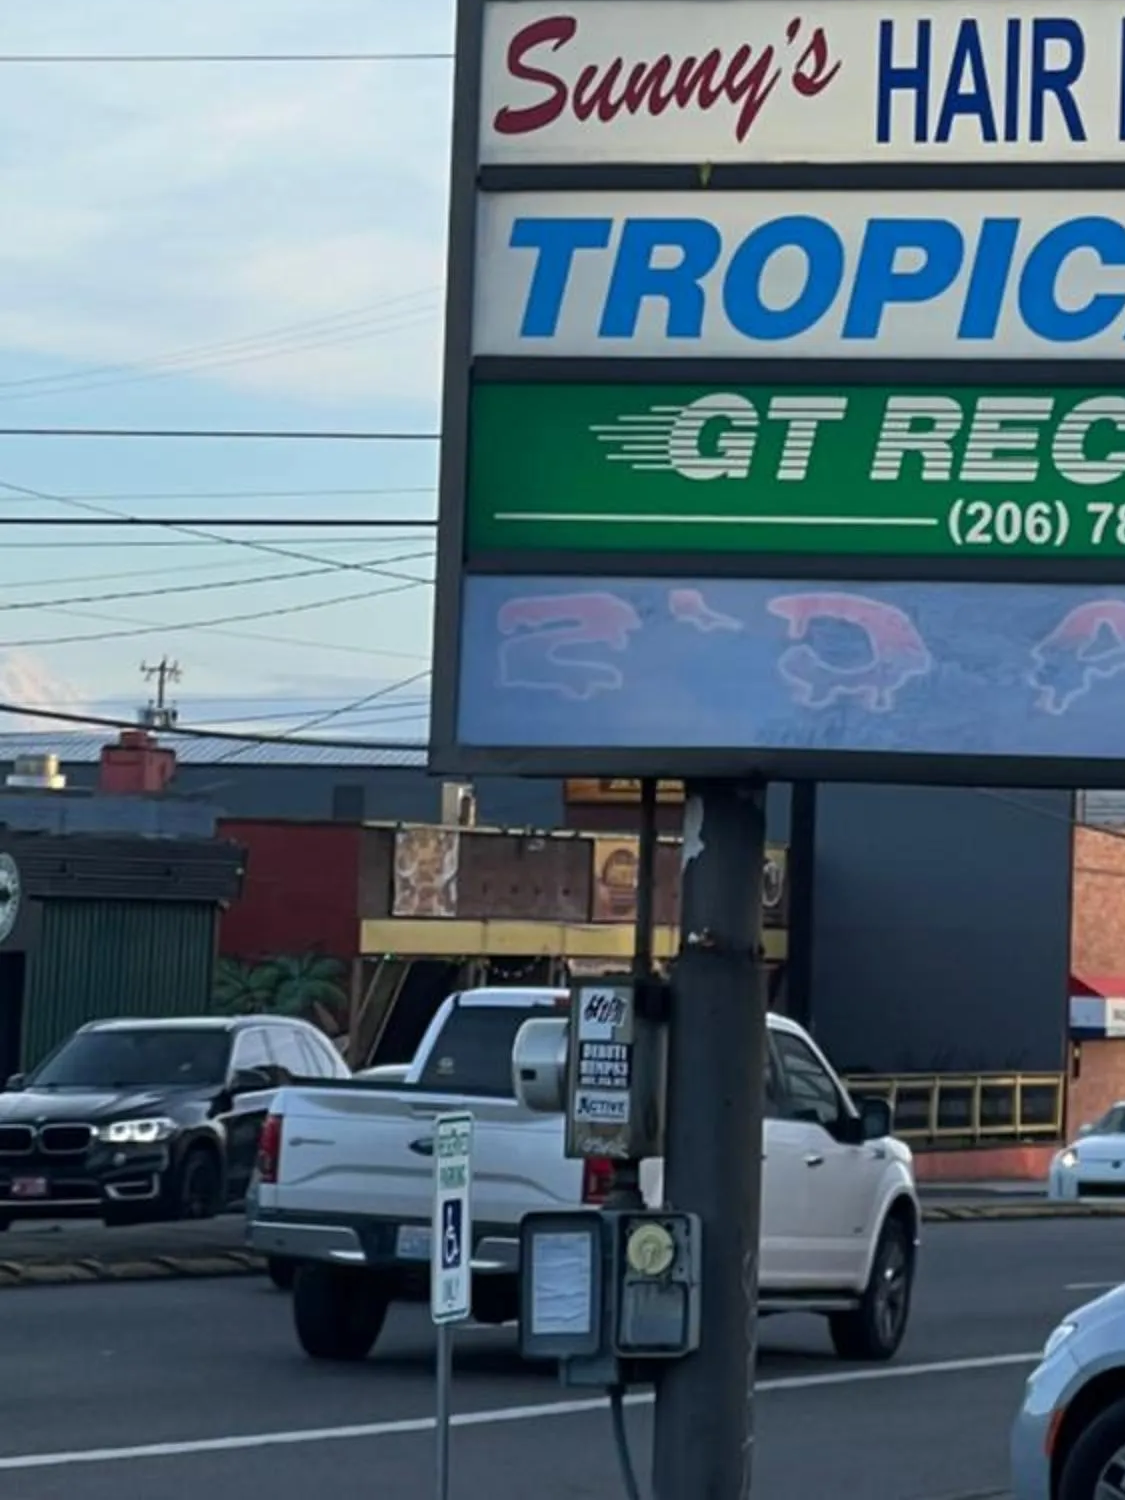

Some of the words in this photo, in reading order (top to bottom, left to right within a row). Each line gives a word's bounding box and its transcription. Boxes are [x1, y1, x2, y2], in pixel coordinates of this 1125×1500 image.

[492, 15, 842, 143] Sunny's
[874, 17, 1087, 145] HAIR
[667, 392, 848, 481] GT
[948, 499, 1070, 547] (206)
